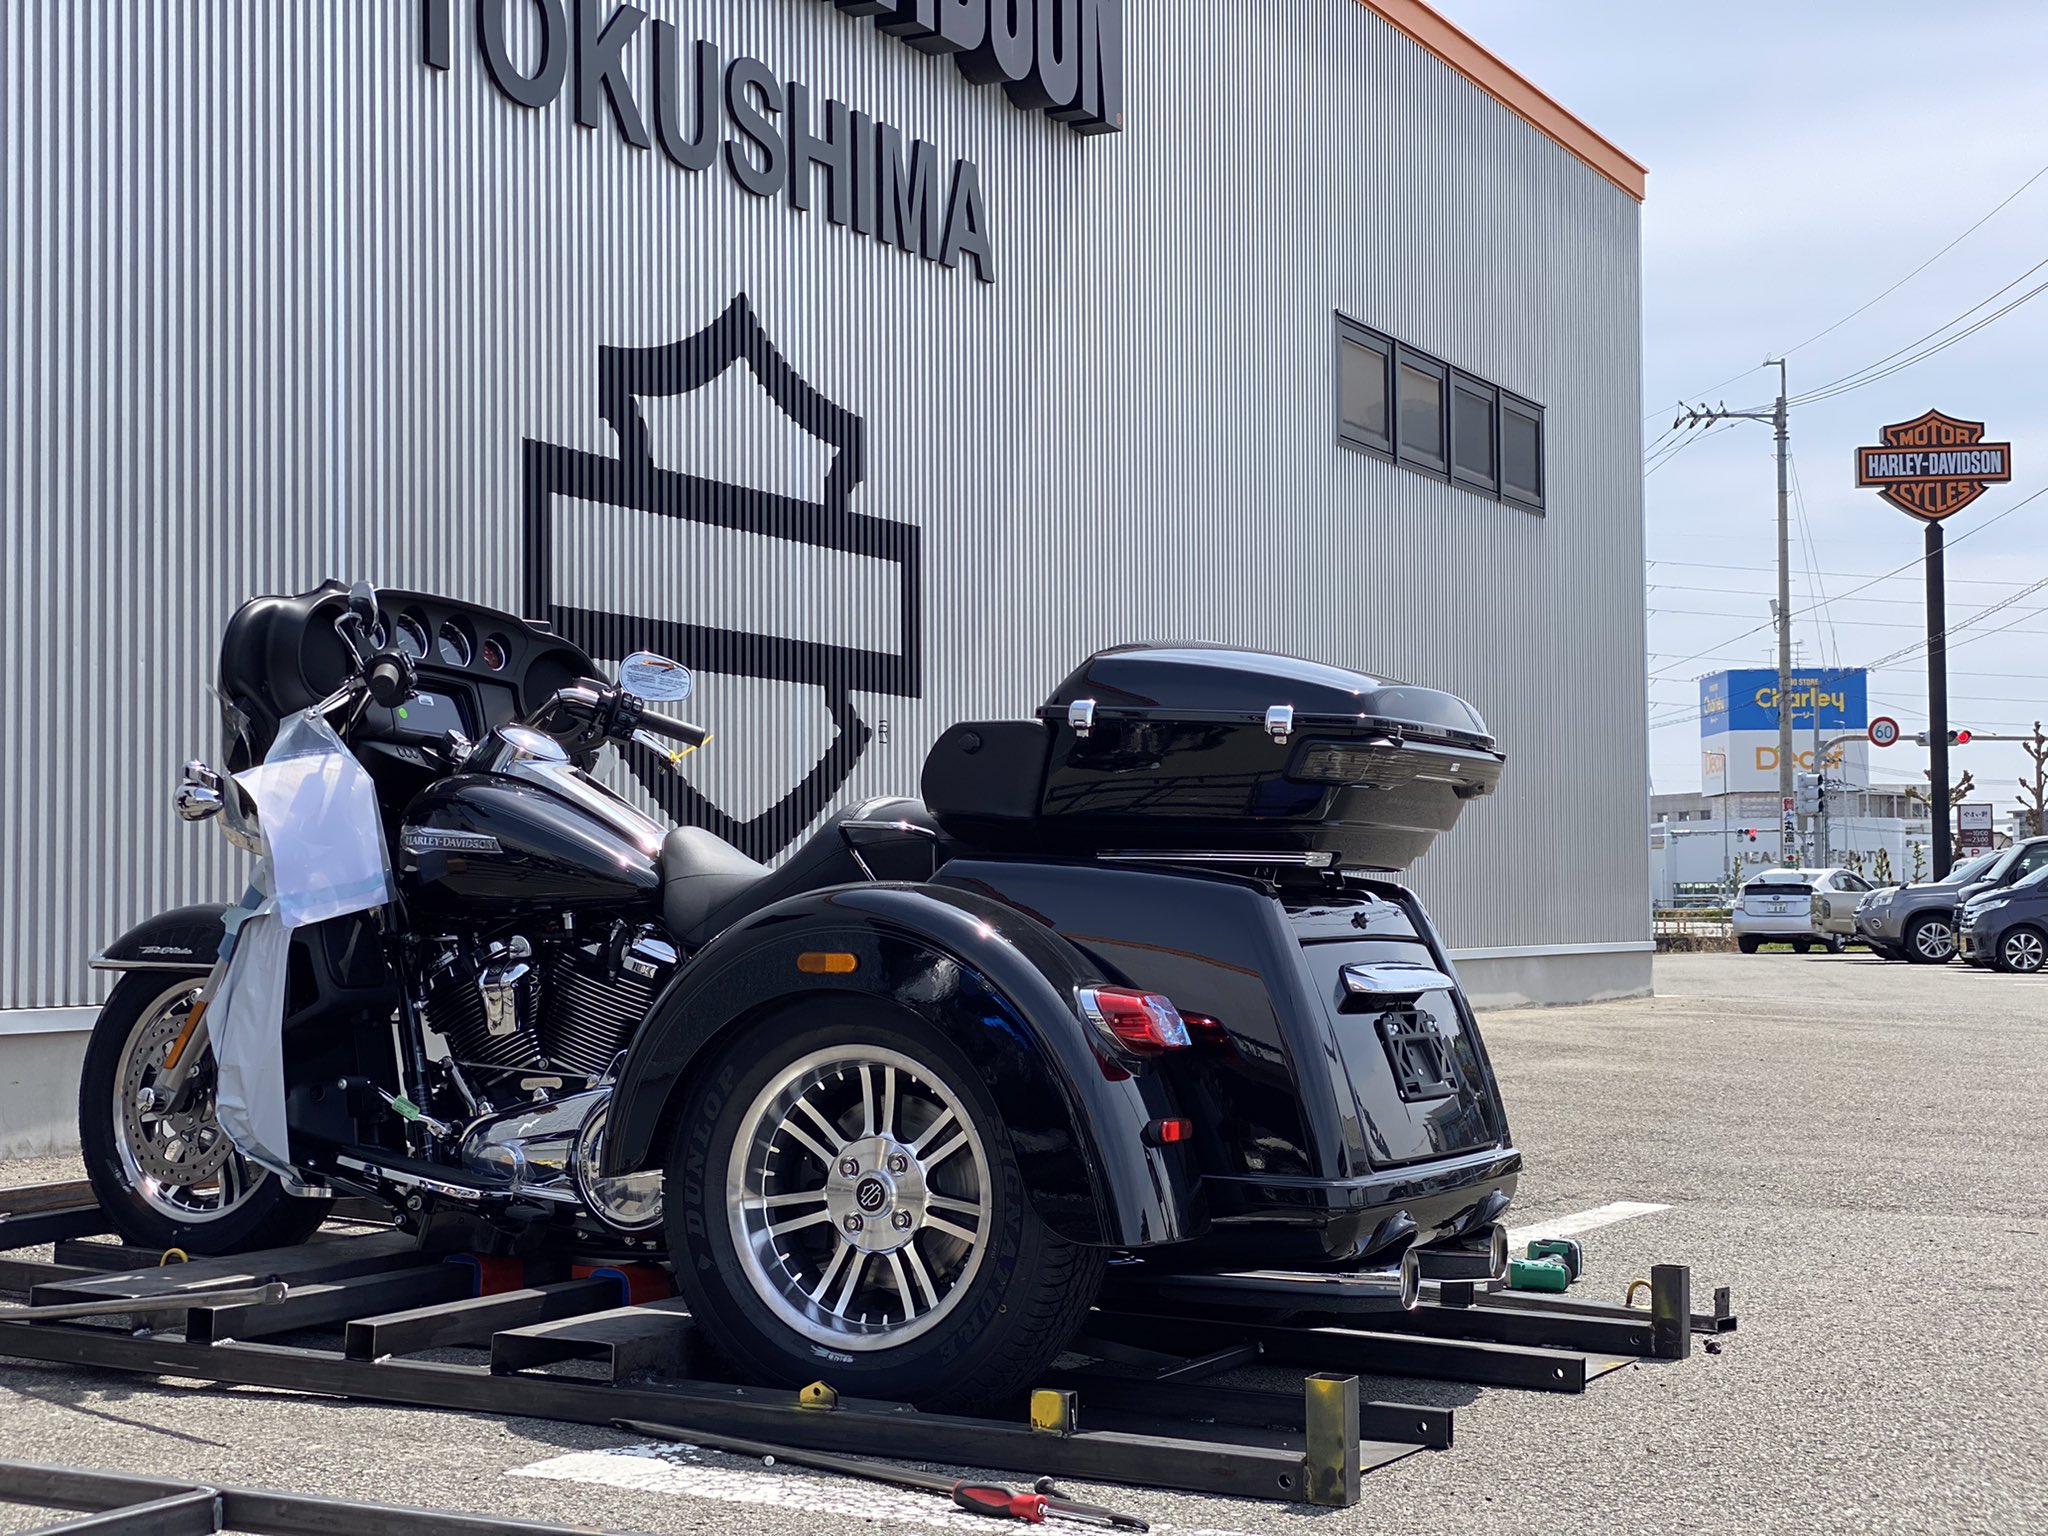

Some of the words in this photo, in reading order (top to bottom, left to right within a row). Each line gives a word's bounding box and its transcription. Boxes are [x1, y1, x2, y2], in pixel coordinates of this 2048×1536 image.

[1900, 420, 1969, 446] MOTOR
[1868, 451, 2002, 477] HARLEY-DAVIDSON
[1900, 482, 1971, 512] CYCLES
[1875, 725, 1893, 739] 60
[405, 835, 496, 849] HARLEY-DAVIDSON
[686, 1063, 735, 1239] DUNLOP
